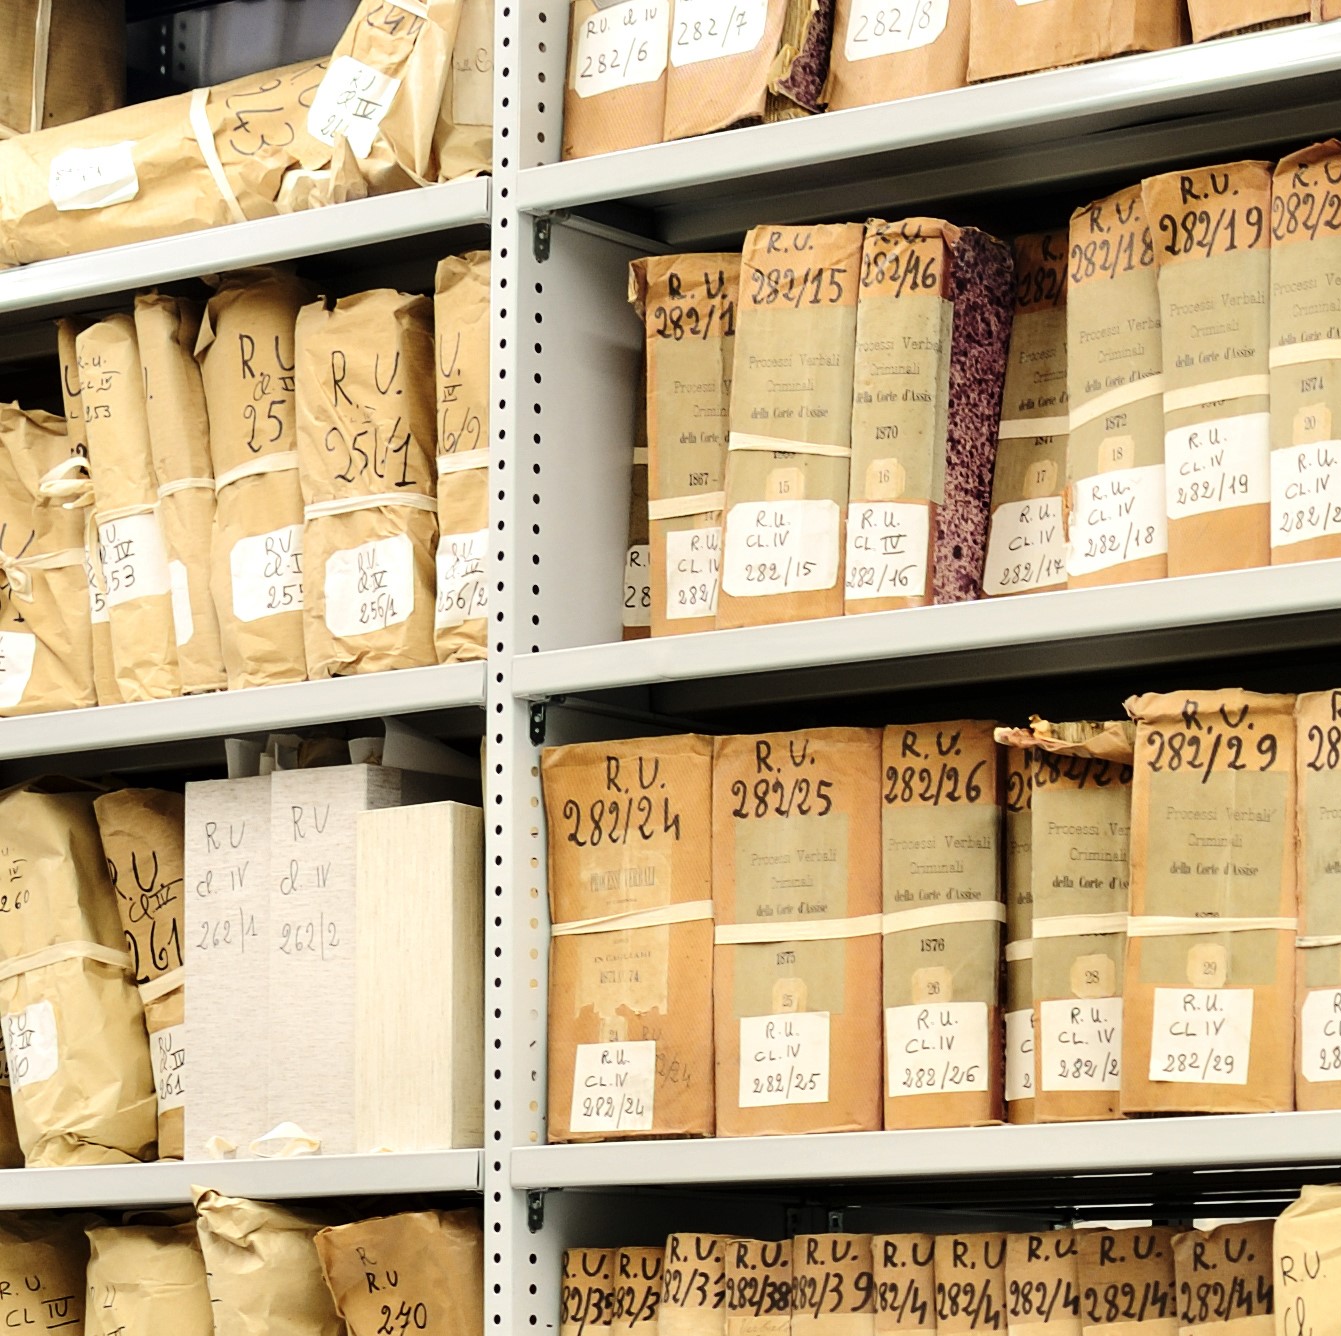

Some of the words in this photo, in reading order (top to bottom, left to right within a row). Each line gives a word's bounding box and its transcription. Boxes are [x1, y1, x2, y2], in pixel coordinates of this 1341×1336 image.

[678, 8, 748, 48] 282/7
[580, 37, 648, 78] 282/6
[1161, 204, 1264, 258] 282/19
[750, 268, 847, 307] 282/15
[1300, 378, 1324, 391] 1874
[874, 425, 899, 439] 1870
[1104, 414, 1127, 429] 1872
[1304, 416, 1316, 429] 20
[1111, 447, 1123, 460] 18
[1177, 472, 1250, 505] 282/19
[1083, 526, 1154, 558] 282/18
[744, 557, 817, 585] 282/15
[845, 562, 915, 590] 282/16
[1147, 727, 1278, 783] 282/29
[732, 777, 833, 819] 282/25
[884, 762, 983, 805] 282/26
[565, 797, 681, 847] 282/24
[196, 908, 257, 954] 262/1
[279, 911, 339, 960] 262/2
[920, 939, 944, 952] 1876
[1085, 971, 1099, 983] 28
[903, 1063, 978, 1089] 282/26
[1162, 1049, 1235, 1079] 282/29
[753, 1066, 821, 1100] 282/25
